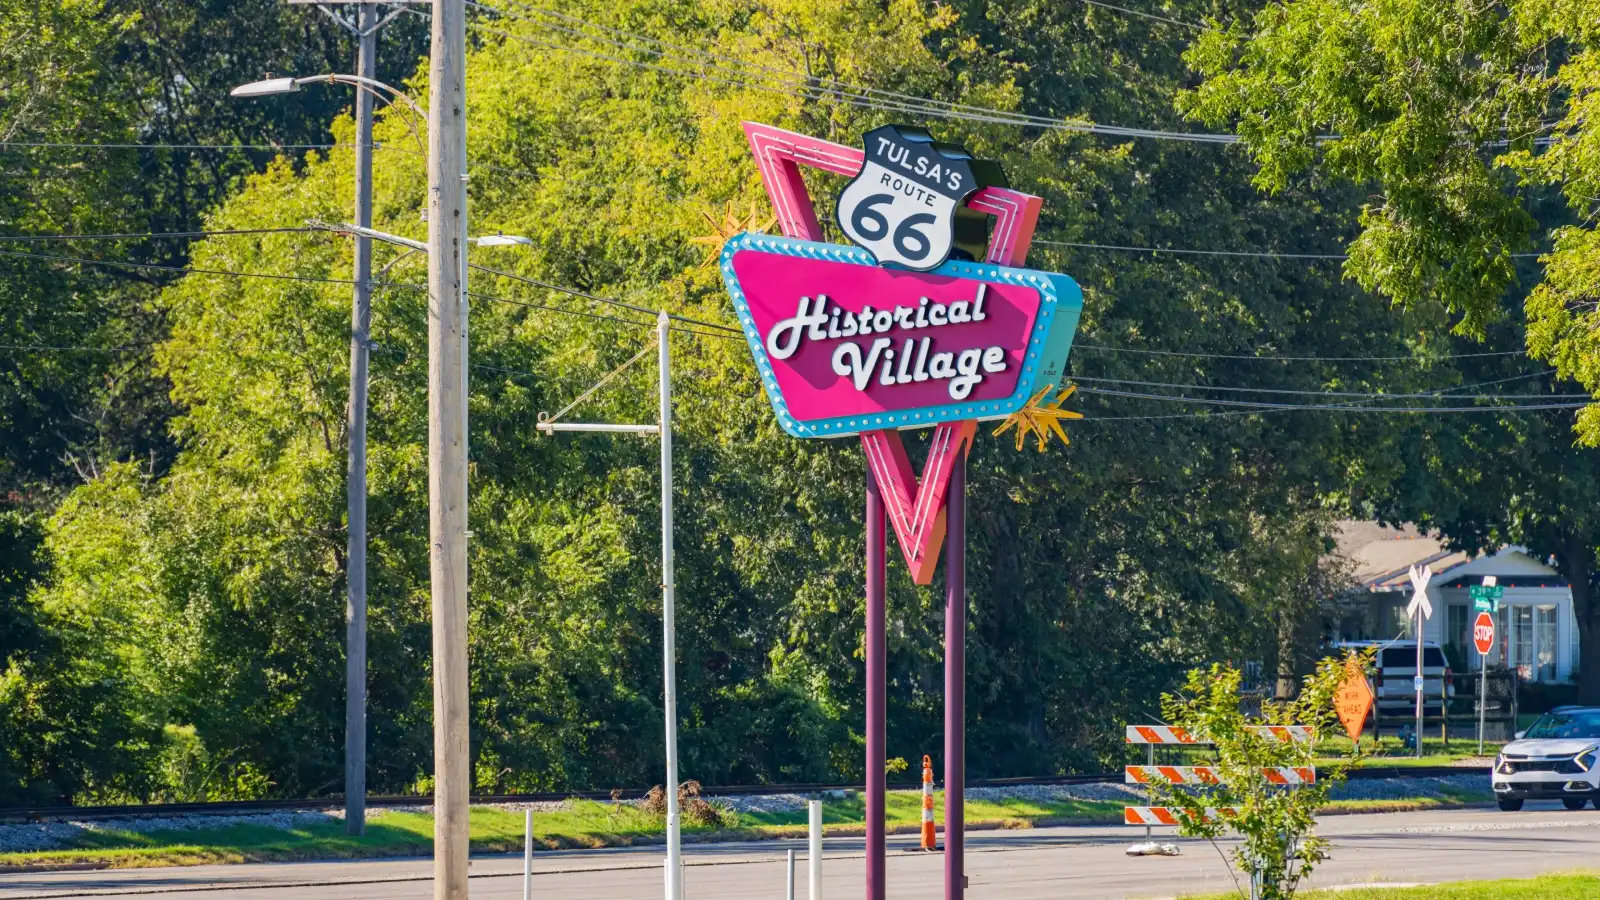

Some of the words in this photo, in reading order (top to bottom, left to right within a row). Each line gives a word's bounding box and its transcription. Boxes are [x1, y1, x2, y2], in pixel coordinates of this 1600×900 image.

[876, 136, 963, 191] TULSA'S
[880, 172, 937, 207] ROUTE
[850, 193, 938, 261] 66
[766, 282, 988, 361] Historical
[831, 335, 1008, 402] Village
[1475, 625, 1493, 641] STOP
